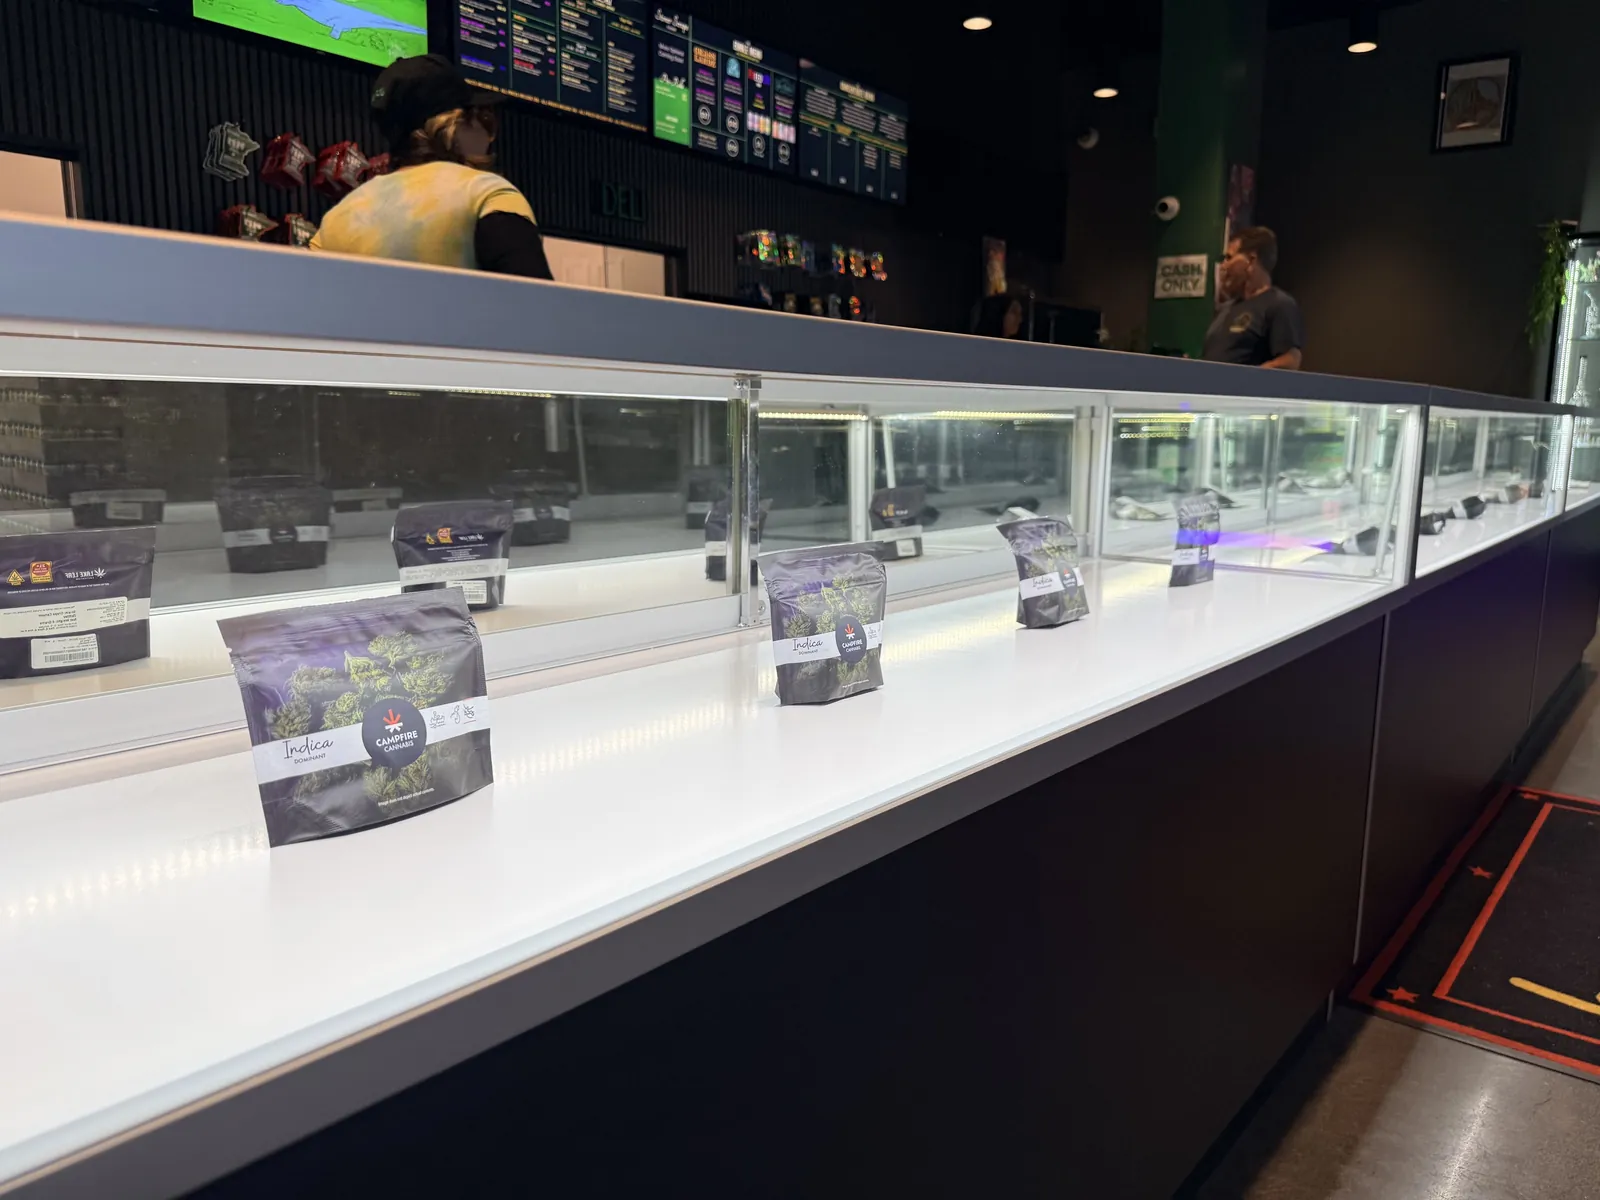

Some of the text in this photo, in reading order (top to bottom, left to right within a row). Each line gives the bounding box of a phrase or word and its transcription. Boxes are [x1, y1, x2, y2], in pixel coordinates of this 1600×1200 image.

[1161, 265, 1203, 278] CASH
[1162, 278, 1200, 292] ONLY
[792, 638, 823, 651] Indica
[841, 638, 863, 649] CAMPFIRE
[375, 730, 419, 747] CAMPFIRE
[282, 736, 334, 760] Indica
[383, 740, 414, 753] CANNABIS
[294, 753, 326, 765] DOMINANT
